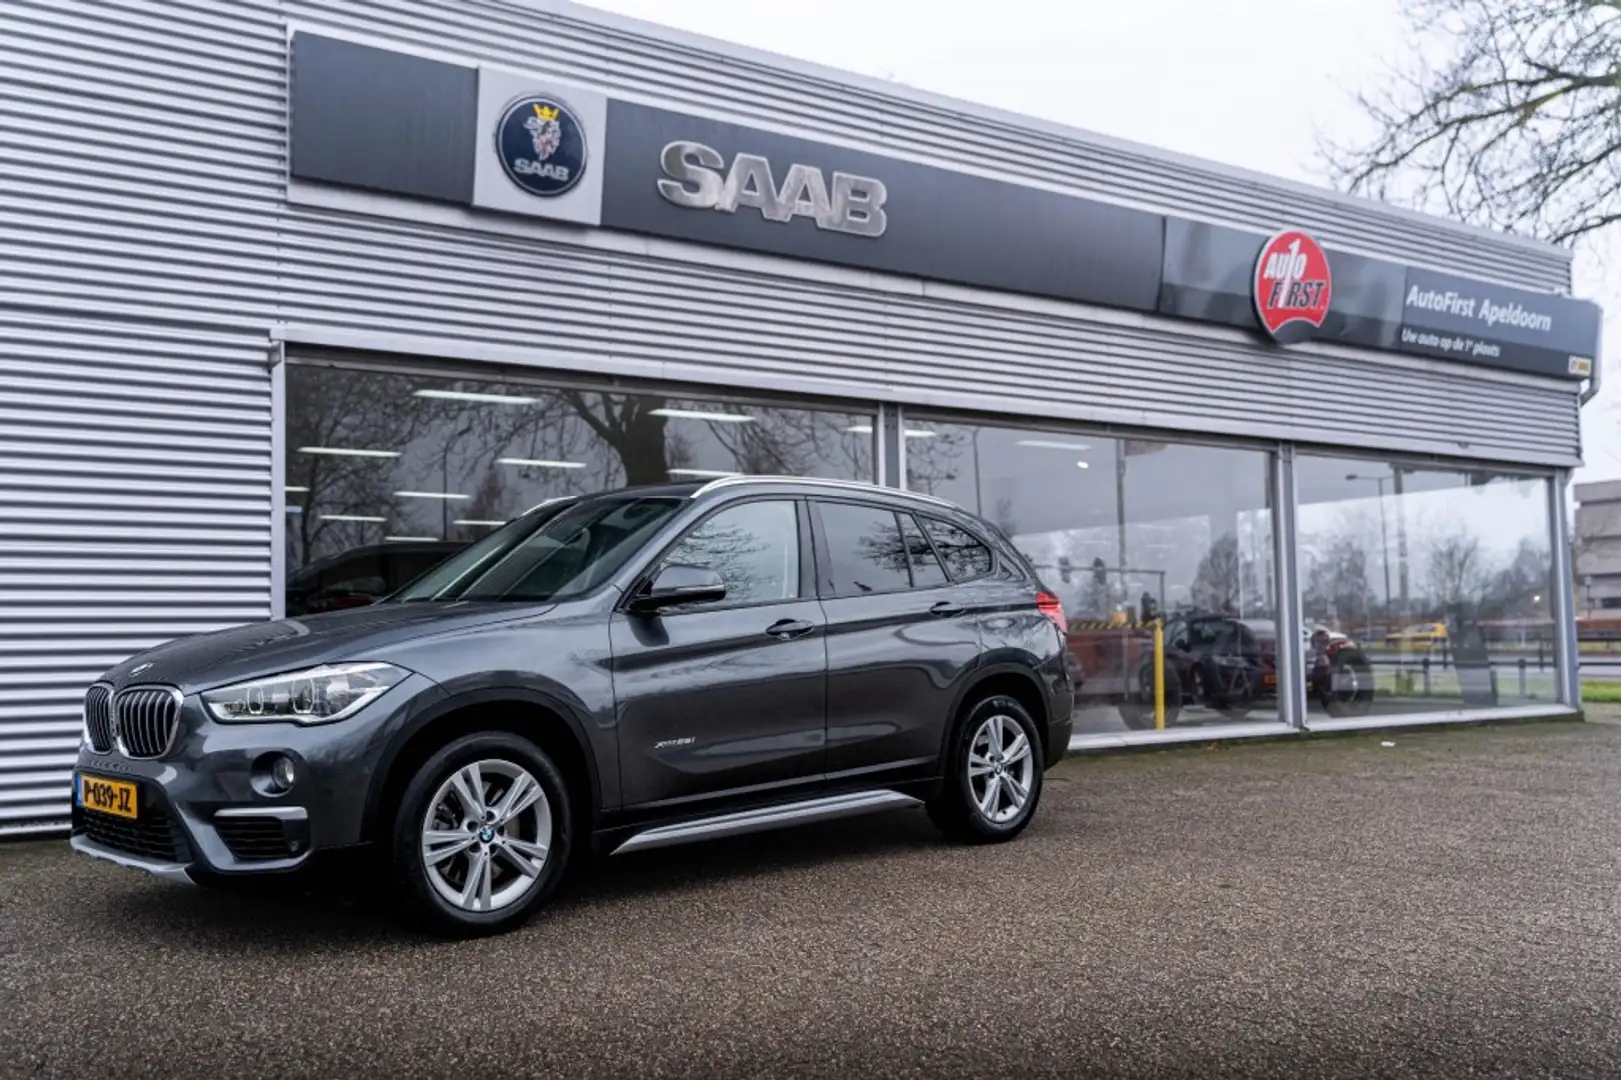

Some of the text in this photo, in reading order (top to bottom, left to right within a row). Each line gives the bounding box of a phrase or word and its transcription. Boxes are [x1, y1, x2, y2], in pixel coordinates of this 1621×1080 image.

[513, 155, 570, 182] SAAB
[657, 140, 888, 238] SAAB
[1406, 286, 1552, 333] AutoFirst Apeldoorn
